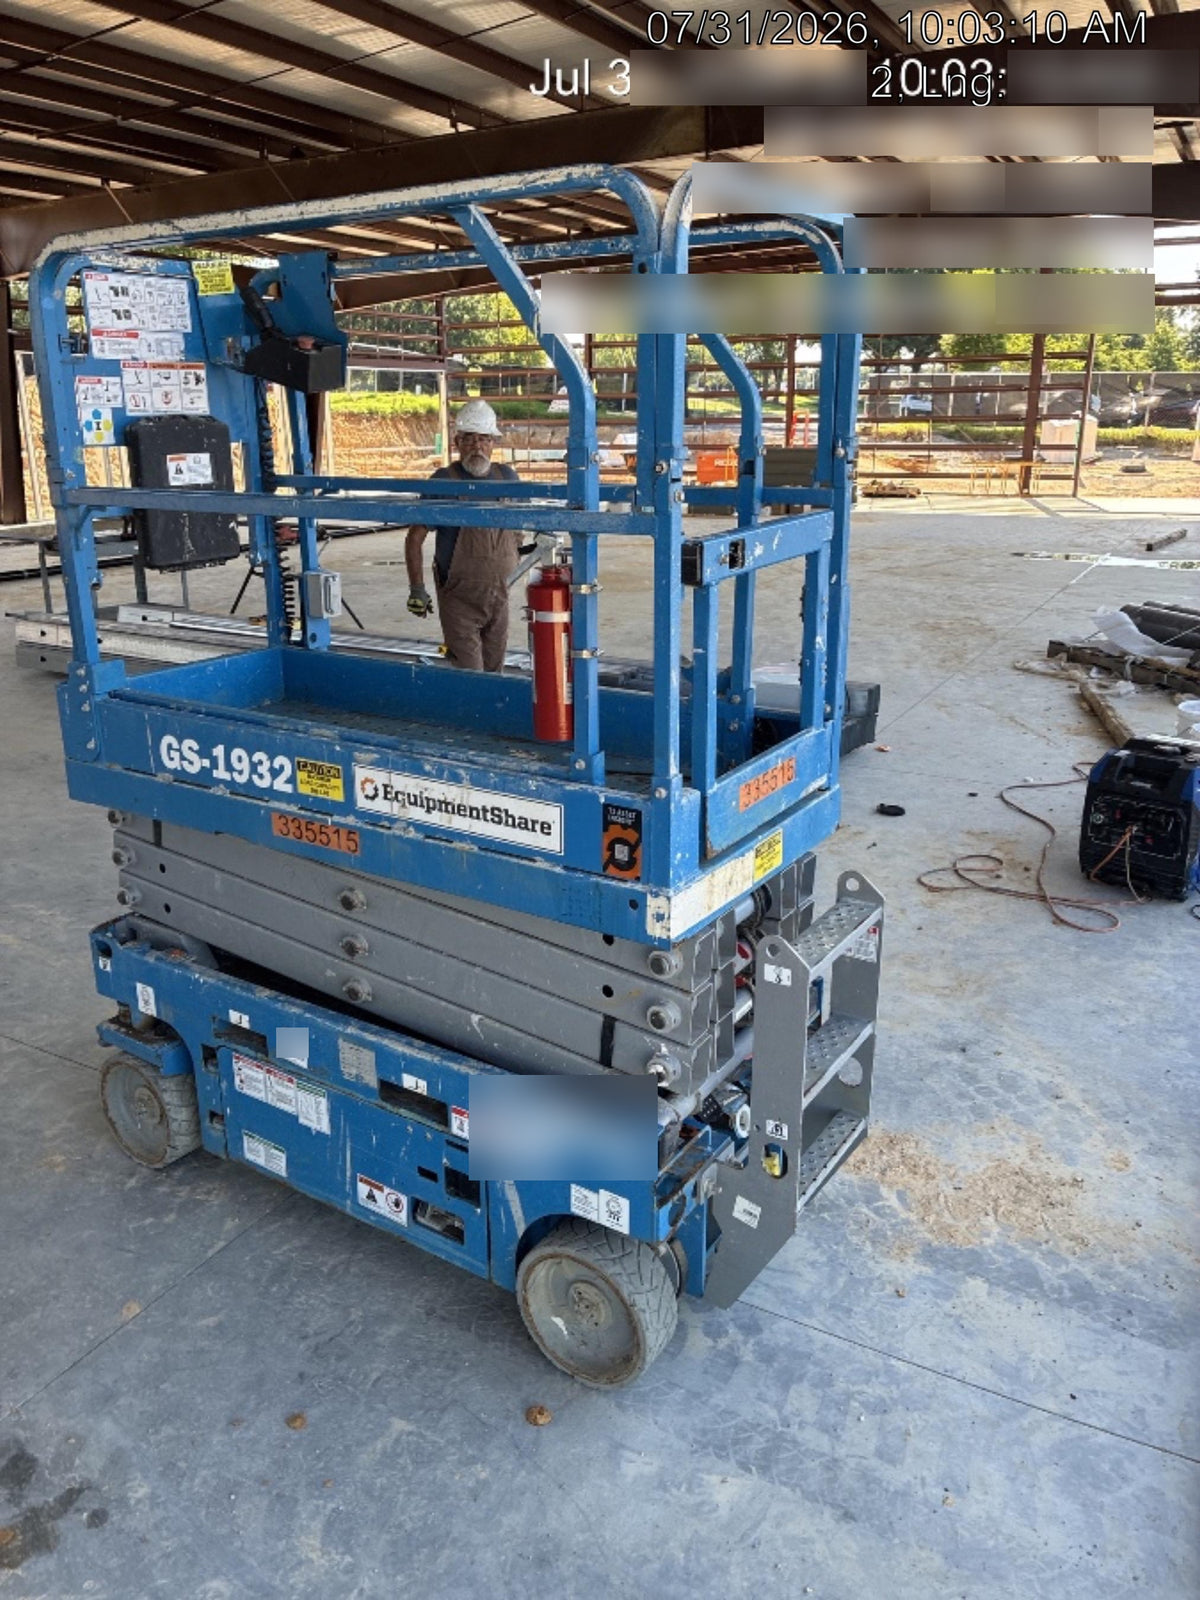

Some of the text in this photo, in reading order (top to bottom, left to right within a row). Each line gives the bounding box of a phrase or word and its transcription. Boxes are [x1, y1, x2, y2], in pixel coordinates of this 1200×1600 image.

[160, 735, 293, 793] GS-1932
[278, 814, 358, 853] 335515
[381, 783, 554, 836] EquipmentShare
